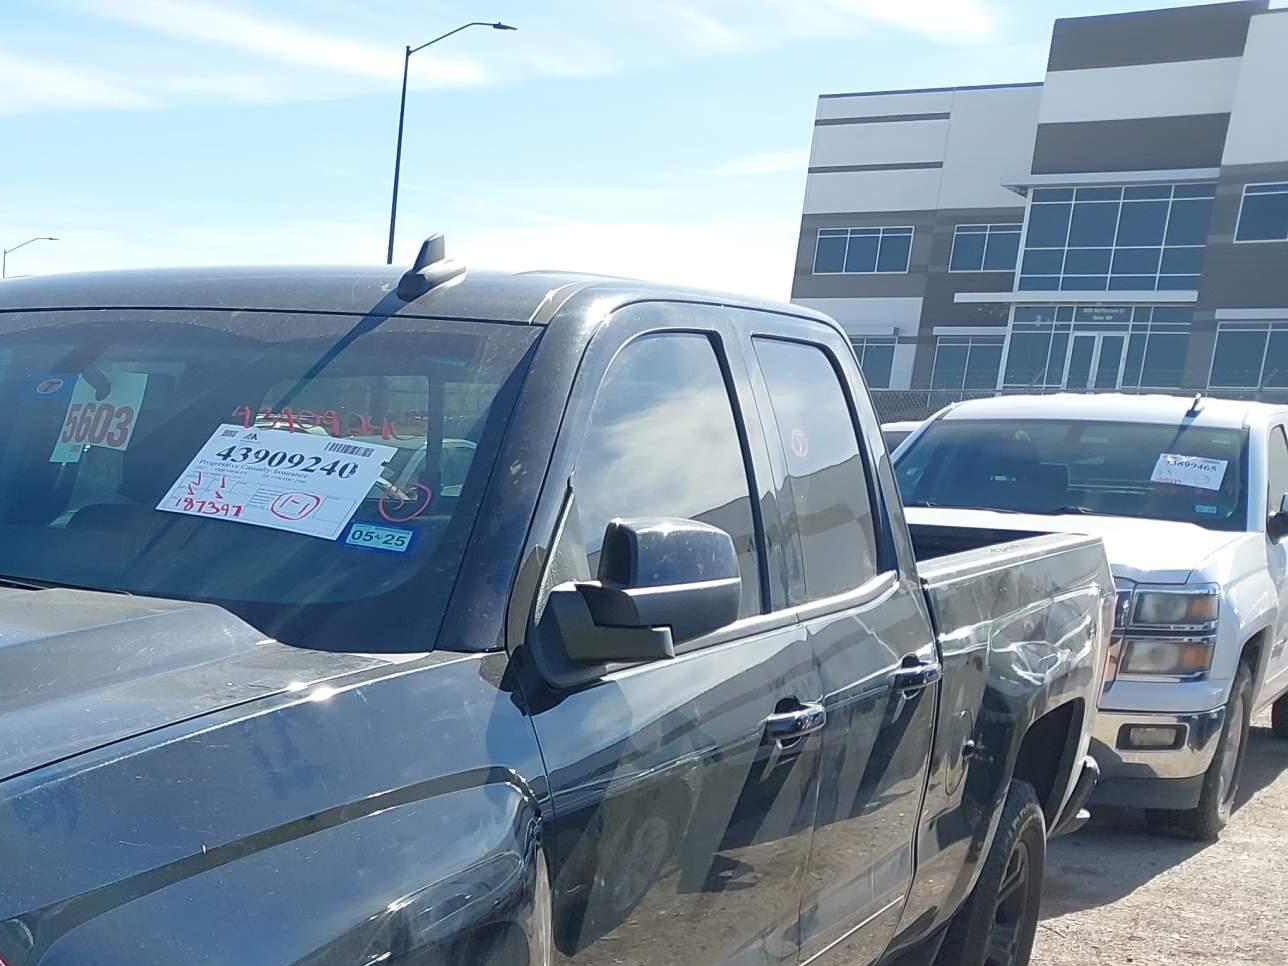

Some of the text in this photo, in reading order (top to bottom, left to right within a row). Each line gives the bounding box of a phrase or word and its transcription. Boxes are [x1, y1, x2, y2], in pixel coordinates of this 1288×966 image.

[61, 401, 134, 447] 5603
[199, 458, 242, 470] Progressive
[215, 445, 359, 480] 43909240
